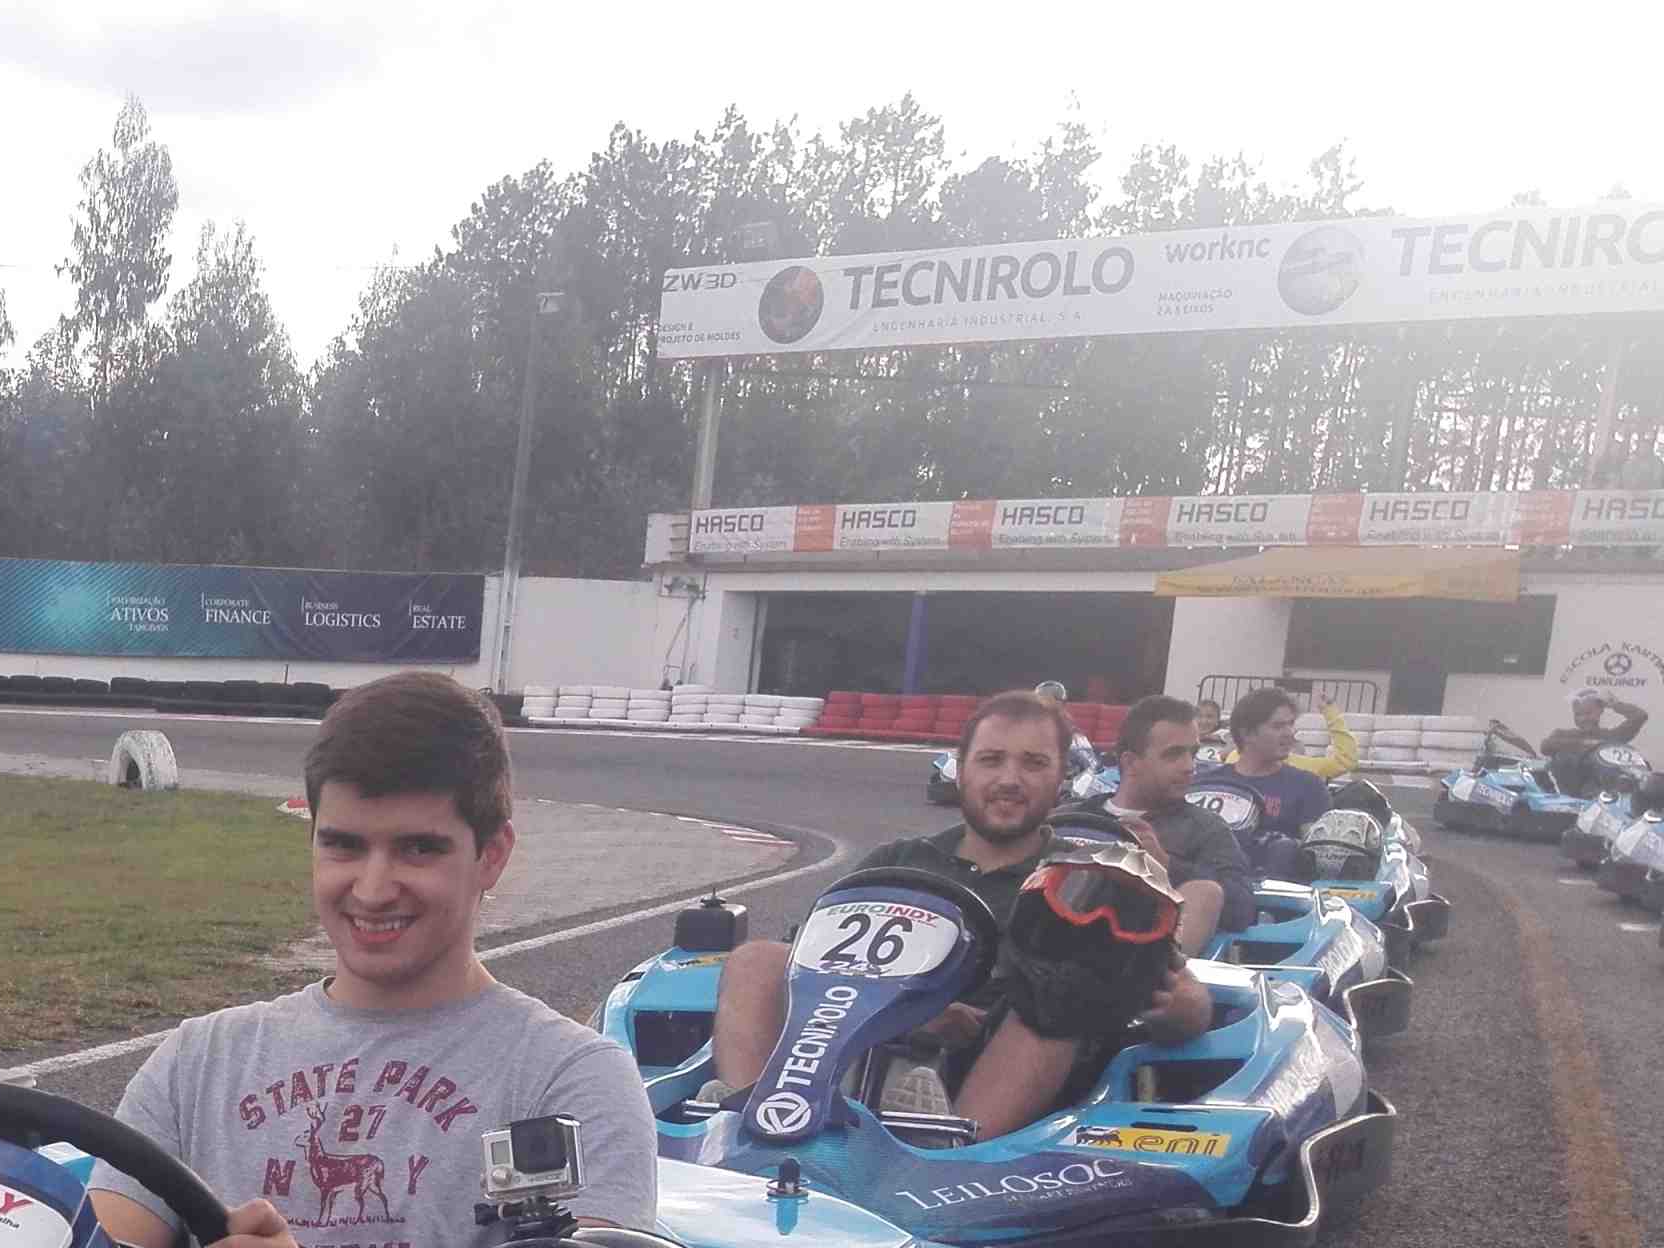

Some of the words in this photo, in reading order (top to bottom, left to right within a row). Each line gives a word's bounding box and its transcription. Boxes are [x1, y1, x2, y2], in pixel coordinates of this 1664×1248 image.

[1165, 232, 1271, 263] worknc
[843, 247, 1135, 310] TECNIROLO
[841, 509, 917, 529] HASCO
[1001, 506, 1084, 526] HASCO
[1176, 502, 1269, 523] HASCO
[1369, 499, 1470, 521] HASCO
[695, 514, 765, 533] HASCO
[111, 607, 169, 622] ATIVOS
[206, 608, 271, 625] FINANCE
[304, 612, 381, 628] LOGISTICS
[413, 615, 466, 629] ESTATE
[827, 903, 939, 921] EUROINDY
[820, 913, 913, 966] 26
[776, 986, 858, 1089] TECNIROLO
[239, 1057, 360, 1130] STATE
[372, 1060, 478, 1132] PARK
[338, 1103, 386, 1143] 27
[1133, 1133, 1220, 1157] eni
[263, 1158, 296, 1197] N
[407, 1153, 431, 1195] Y
[896, 1157, 1123, 1210] LEILOSOC
